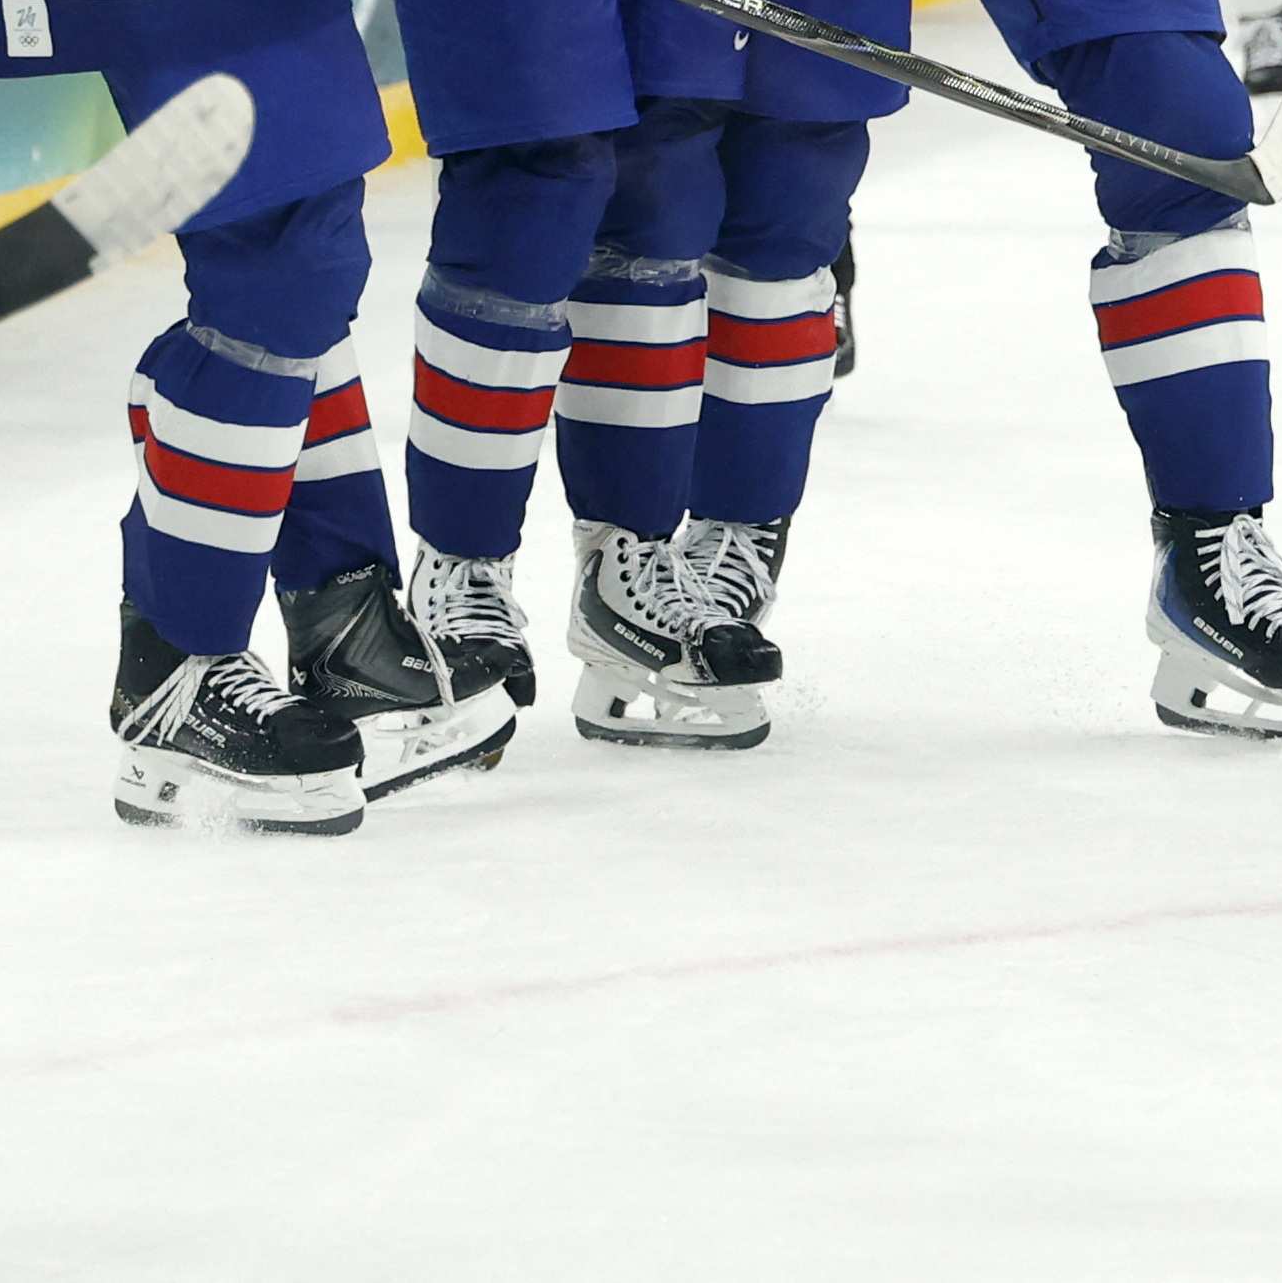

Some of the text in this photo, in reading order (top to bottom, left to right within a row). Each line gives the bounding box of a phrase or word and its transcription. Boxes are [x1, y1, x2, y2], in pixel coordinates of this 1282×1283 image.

[1100, 125, 1183, 166] FLYLITE
[613, 622, 667, 662] BAUER
[1192, 616, 1245, 660] BAUER
[183, 712, 227, 750] AUER
